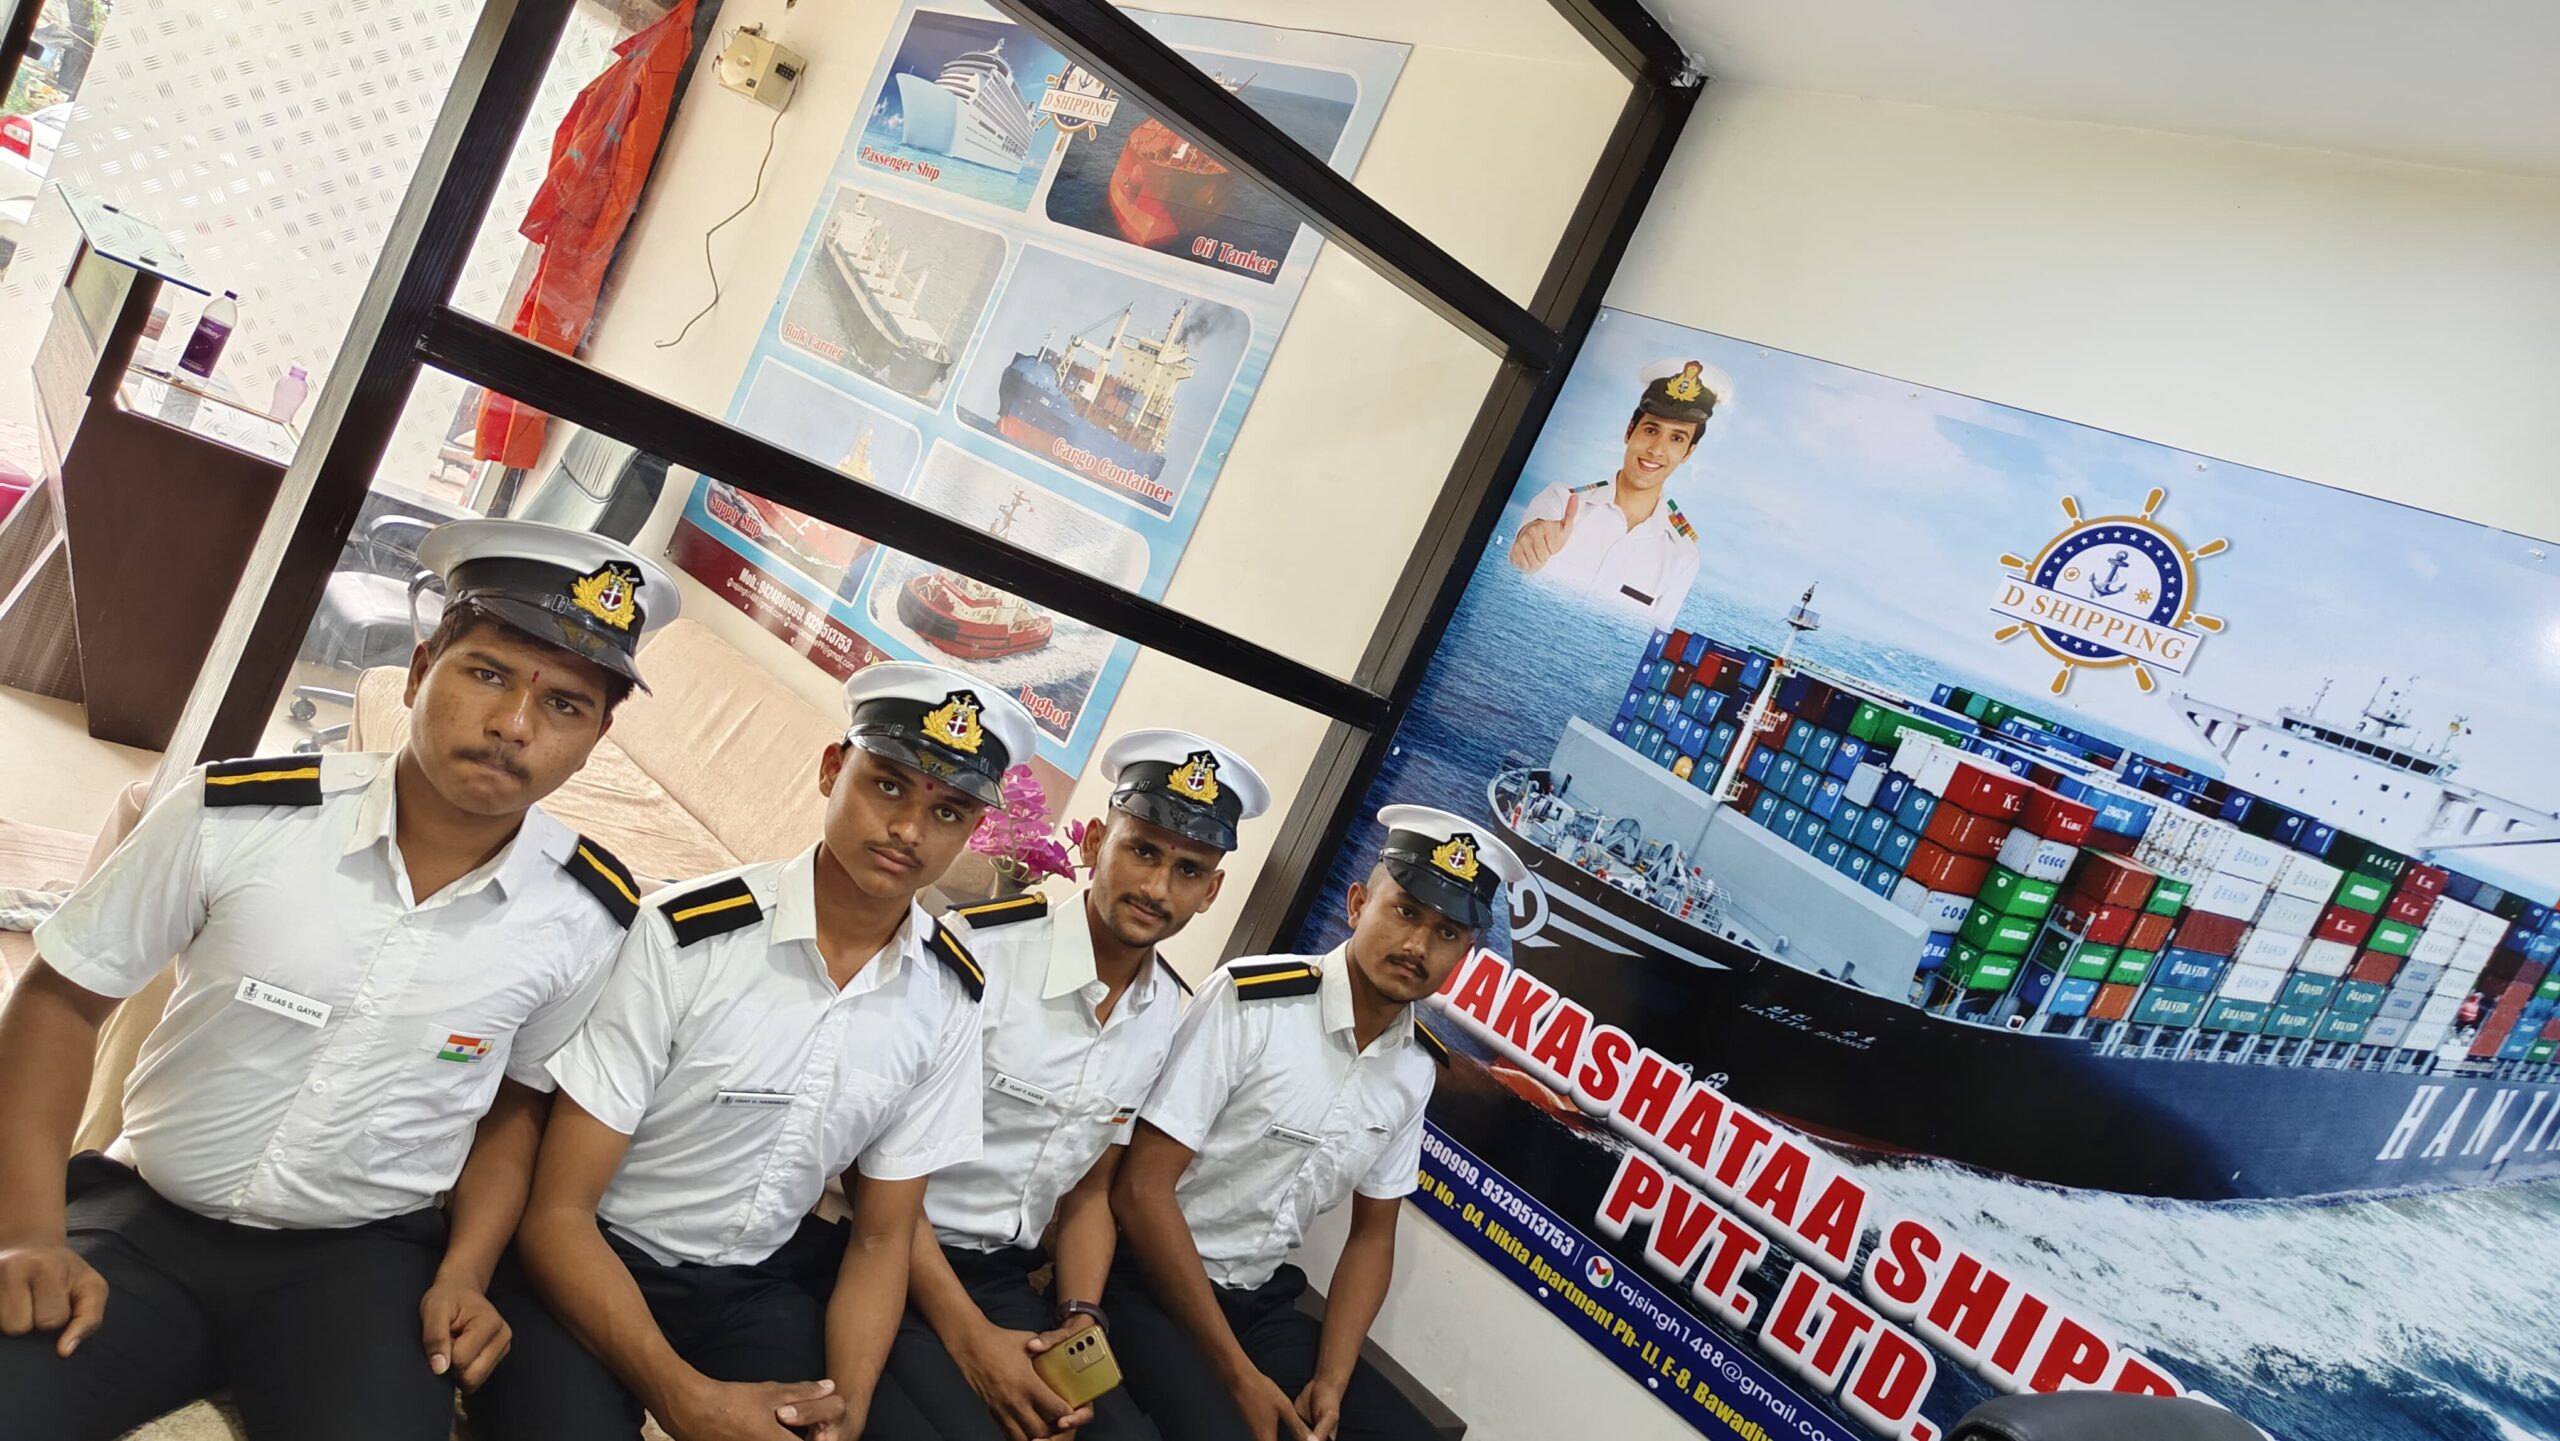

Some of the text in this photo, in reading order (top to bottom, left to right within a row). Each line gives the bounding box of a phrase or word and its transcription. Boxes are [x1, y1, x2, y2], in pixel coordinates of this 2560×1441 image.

[1043, 93, 1112, 118] D SHIPPING
[861, 146, 941, 182] Passenger Ship
[1192, 236, 1278, 275] Oil Tanker
[785, 321, 846, 361] Bulk Carrier
[1053, 437, 1174, 503] Cargo Container
[709, 494, 762, 538] Supply Ship
[804, 612, 852, 653] 9329513753
[2001, 584, 2186, 660] D SHIPPING
[1019, 683, 1071, 729] Tugbot
[2038, 853, 2066, 869] COSCO
[1941, 906, 1968, 922] COS
[262, 992, 288, 1009] TEJAS
[296, 1004, 323, 1020] GAYKE
[1740, 1003, 1870, 1050] HANJIN SOOHO
[1480, 1177, 1576, 1256] 9329513753
[1416, 1169, 1436, 1192] op
[1434, 1180, 1462, 1210] No.-
[1461, 1202, 1484, 1232] 04,
[1484, 1220, 1531, 1265] Nikita
[1529, 1254, 1615, 1331] Apartment
[1612, 1313, 1641, 1348] Ph-
[1660, 1356, 1692, 1395] E-8,
[1605, 1154, 1933, 1441] PVT. LTD.
[1614, 1279, 1834, 1441] rajsingh1488@gmail.co
